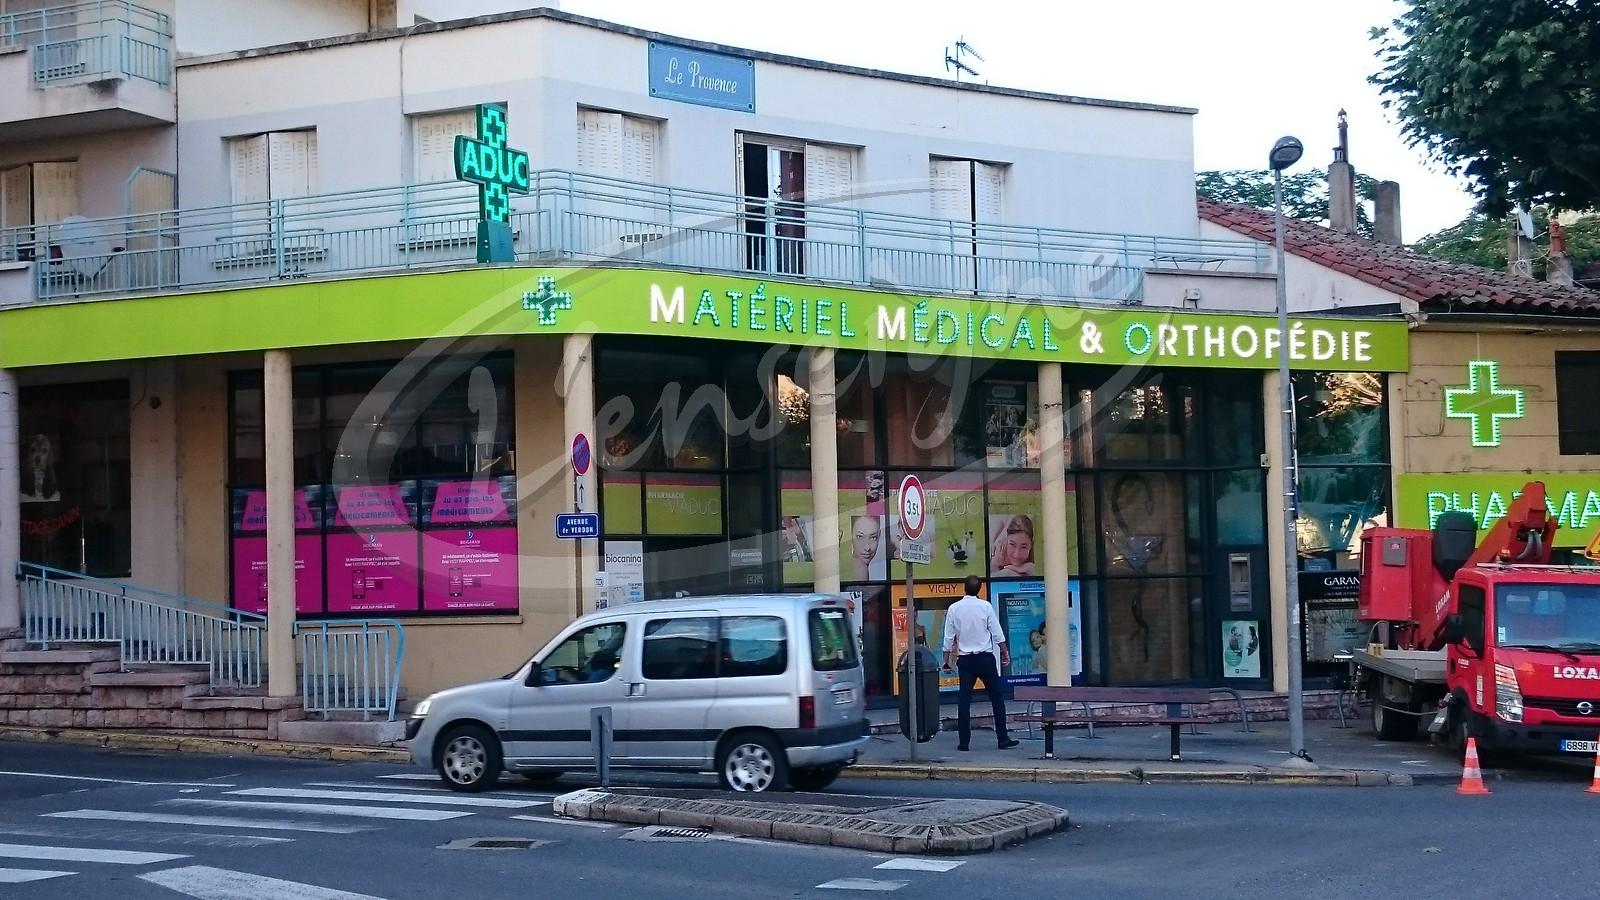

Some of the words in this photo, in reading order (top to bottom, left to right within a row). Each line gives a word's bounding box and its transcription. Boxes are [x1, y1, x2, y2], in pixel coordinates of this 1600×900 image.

[664, 57, 684, 85] Le
[687, 60, 738, 94] Provence
[463, 140, 528, 188] ADUC
[650, 283, 856, 338] MATÉRIEL
[877, 300, 1059, 353] MÉDICAL
[1079, 321, 1105, 355] &
[1124, 321, 1374, 362] ORTHOPÉDIE
[1427, 490, 1600, 531] PHAMA
[605, 553, 642, 563] biocanina
[1323, 576, 1360, 586] GARAN
[928, 583, 958, 594] VICHY
[1553, 666, 1600, 679] LOXA
[1566, 741, 1588, 751] 6898
